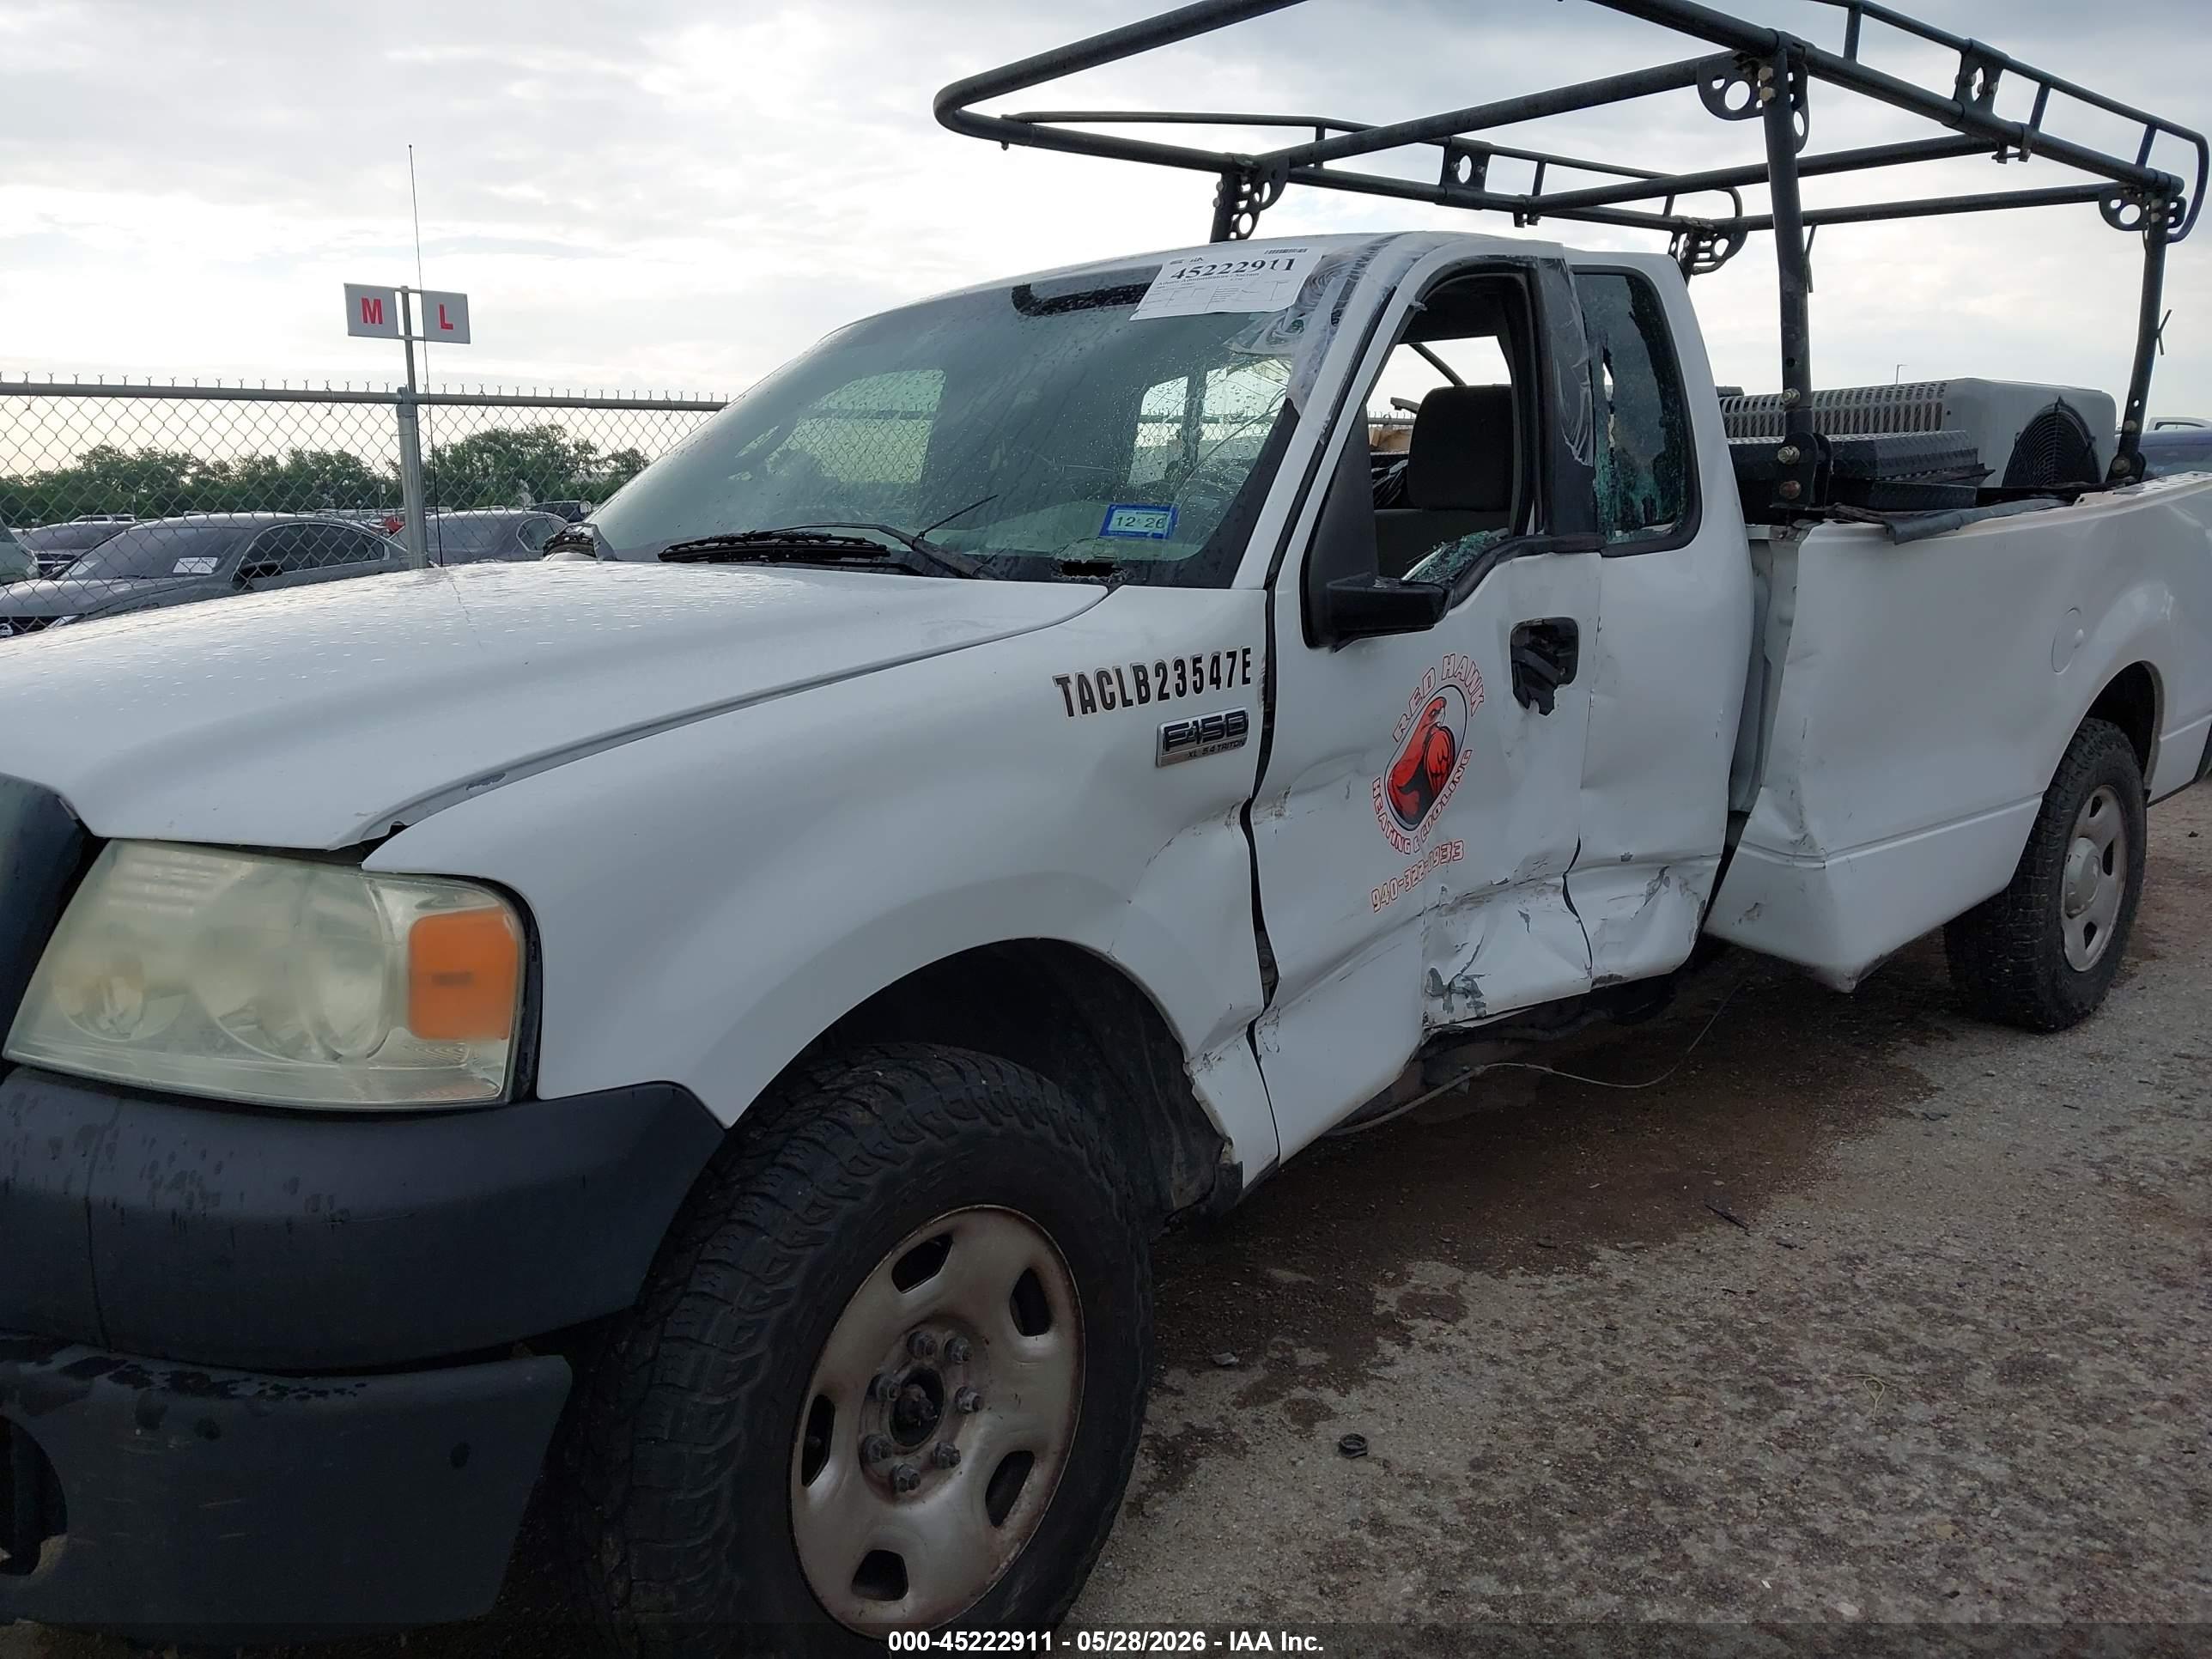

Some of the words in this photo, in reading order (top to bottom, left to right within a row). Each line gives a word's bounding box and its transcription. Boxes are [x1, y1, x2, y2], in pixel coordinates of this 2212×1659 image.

[1170, 258, 1296, 280] 45222911
[361, 297, 384, 325] M
[439, 304, 453, 331] L
[1116, 516, 1136, 527] 12
[1054, 647, 1252, 717] TACLB23547E
[1393, 666, 1437, 743] RED
[1442, 653, 1485, 717] HAWK
[1372, 777, 1412, 855] HEATING
[1420, 750, 1473, 842] COOLING
